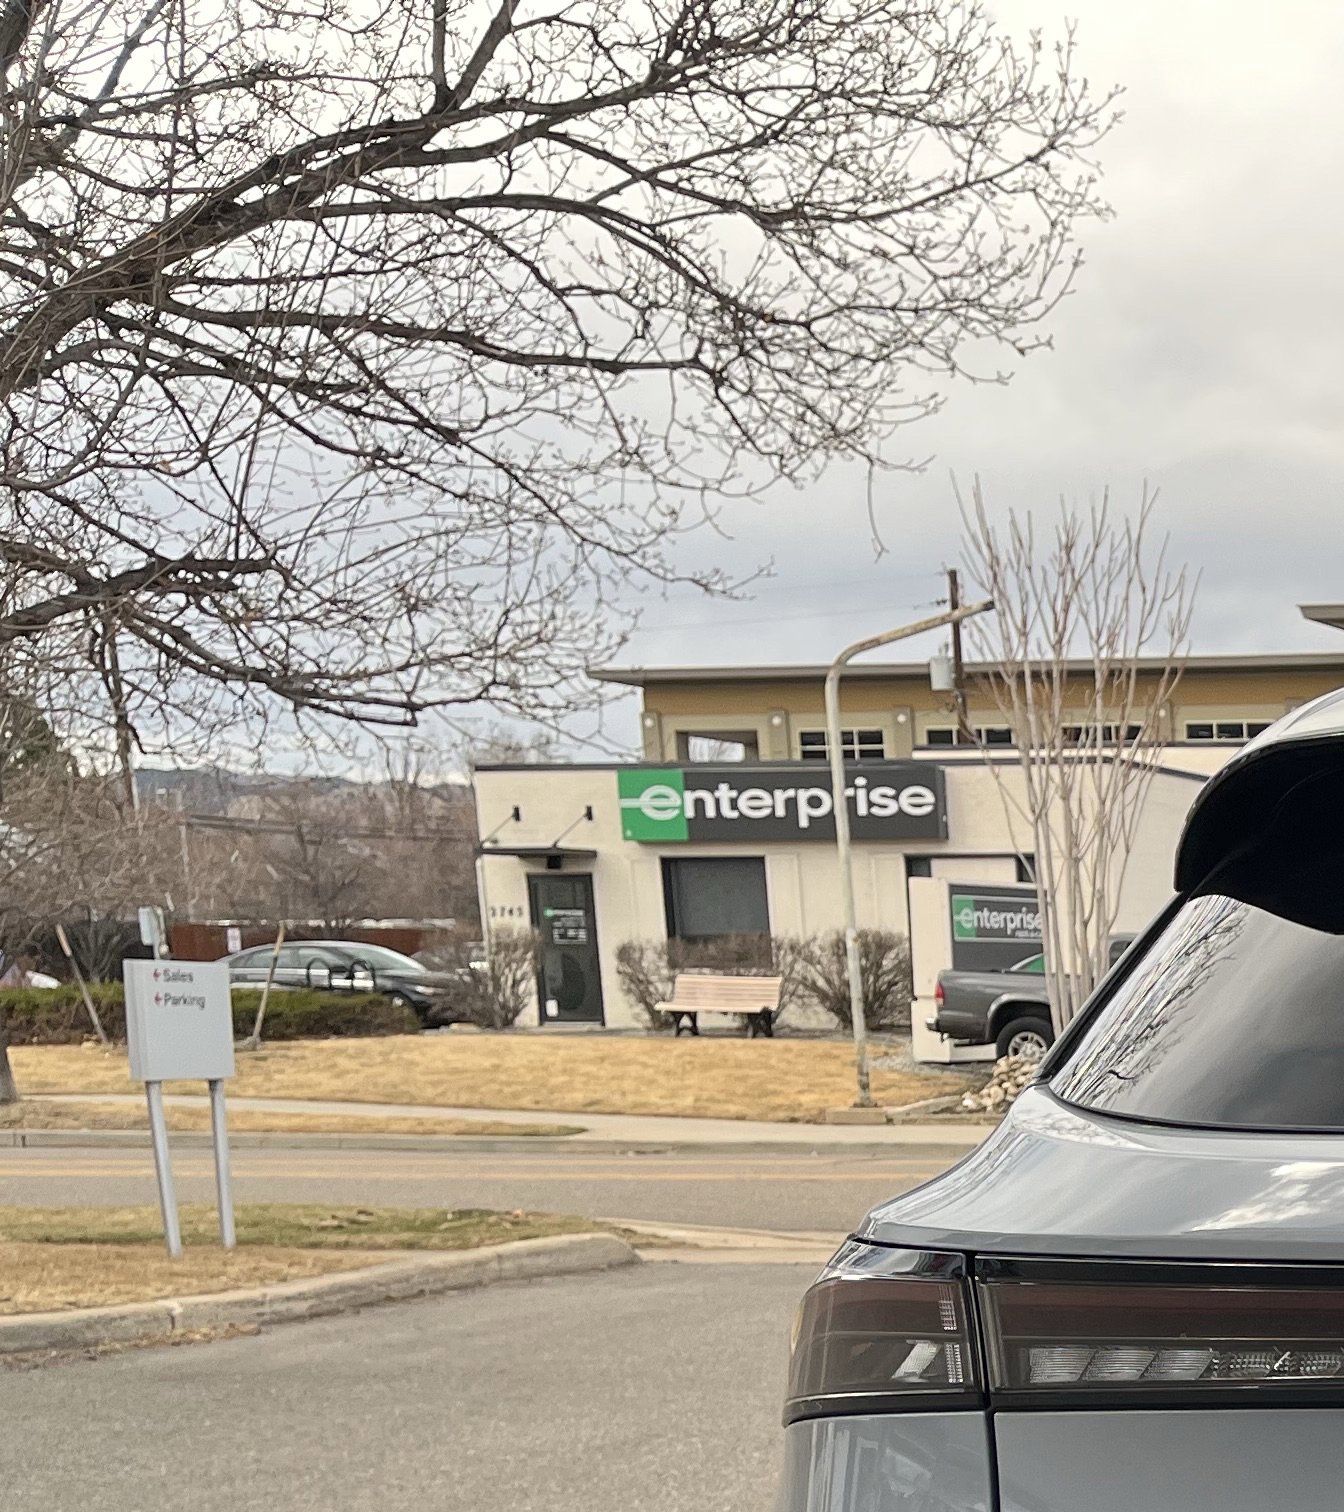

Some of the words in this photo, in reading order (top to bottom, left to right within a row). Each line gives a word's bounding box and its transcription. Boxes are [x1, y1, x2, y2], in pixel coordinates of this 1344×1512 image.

[620, 776, 936, 828] enterpise
[163, 968, 194, 983] Sales
[164, 993, 206, 1010] Parking
